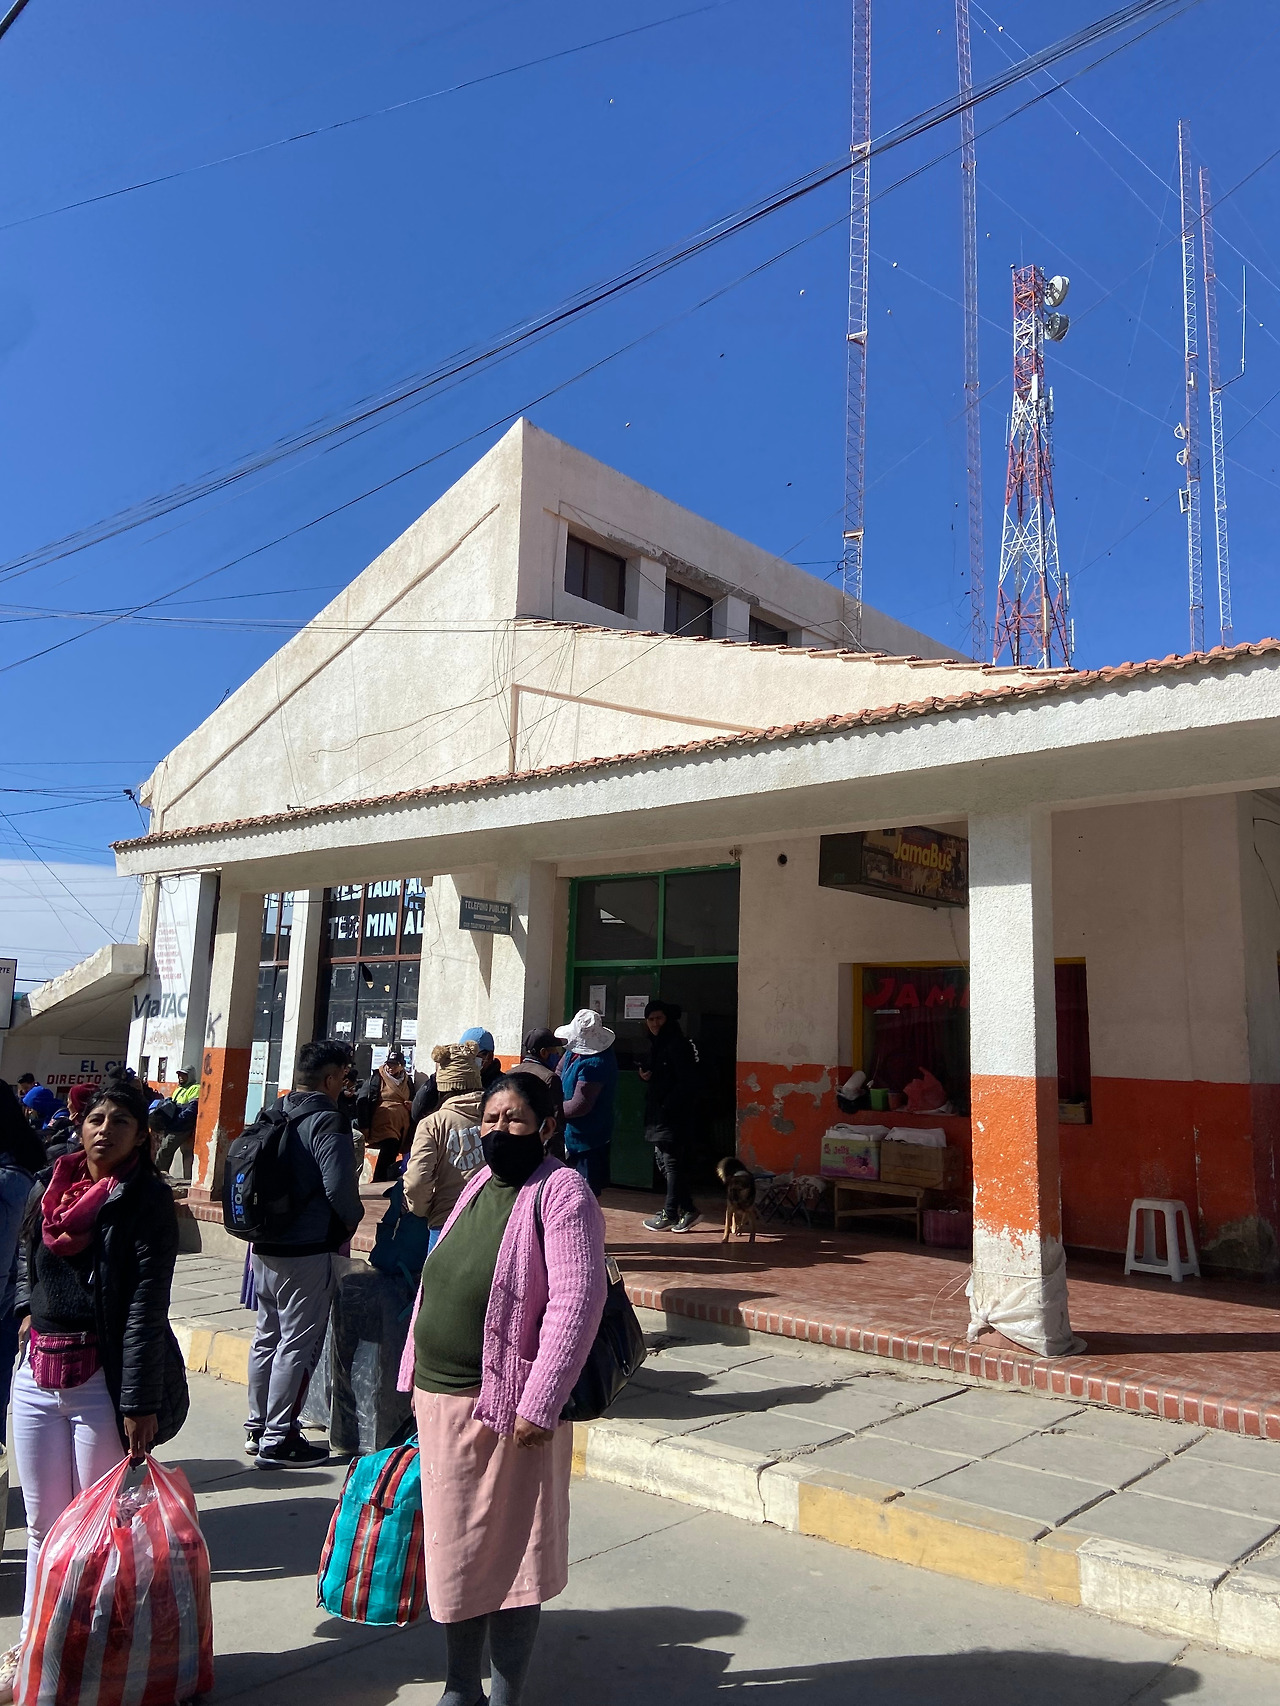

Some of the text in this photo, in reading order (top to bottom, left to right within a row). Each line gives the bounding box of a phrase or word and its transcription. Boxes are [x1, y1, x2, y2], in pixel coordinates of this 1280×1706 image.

[893, 834, 952, 872] JamaBus
[80, 1059, 99, 1073] EL
[234, 1172, 246, 1224] SPORT
